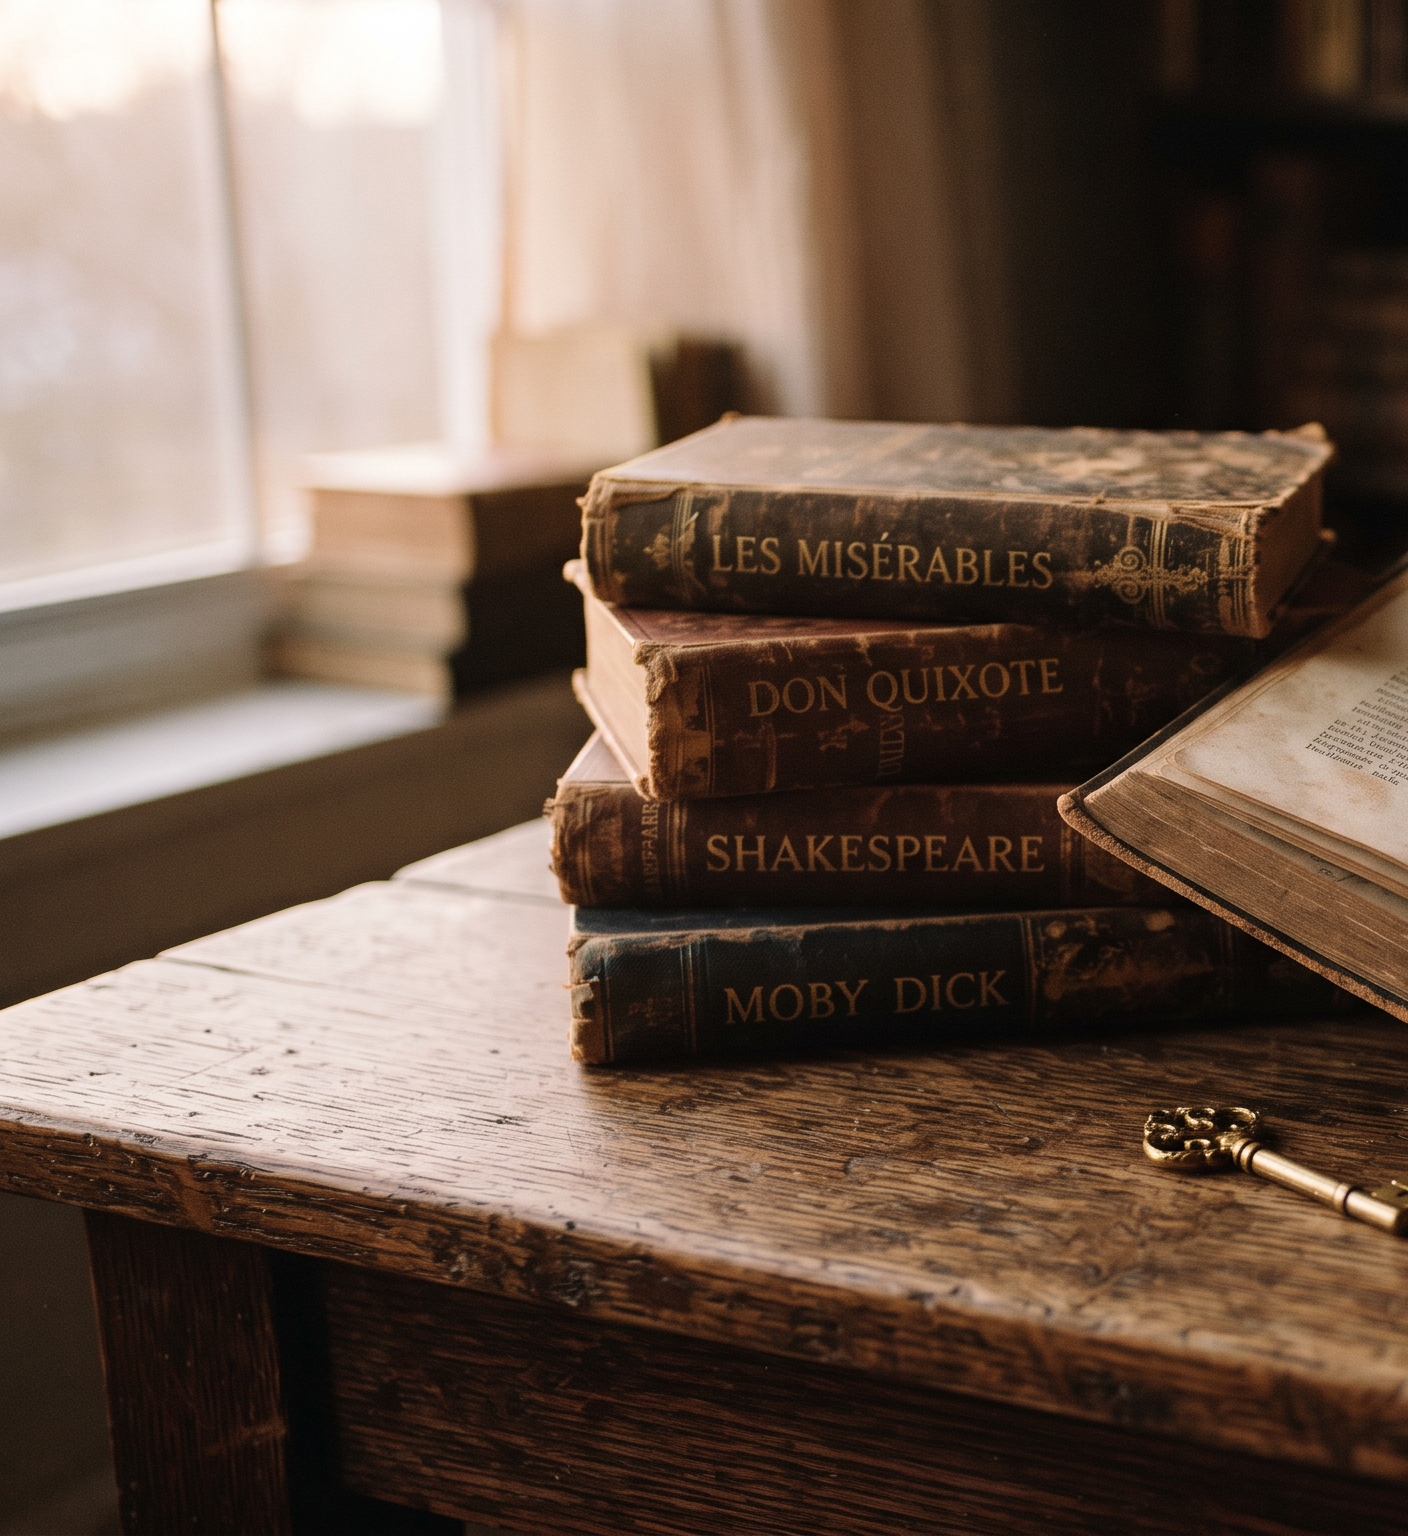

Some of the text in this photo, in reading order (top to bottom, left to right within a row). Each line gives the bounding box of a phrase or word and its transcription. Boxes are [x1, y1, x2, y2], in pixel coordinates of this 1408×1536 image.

[711, 532, 1055, 589] LES MISÉRABLES
[747, 657, 1064, 717] DON QUIXOTE
[706, 834, 1046, 872] SHAKESPEARE
[726, 971, 1010, 1024] MOBY DICK
